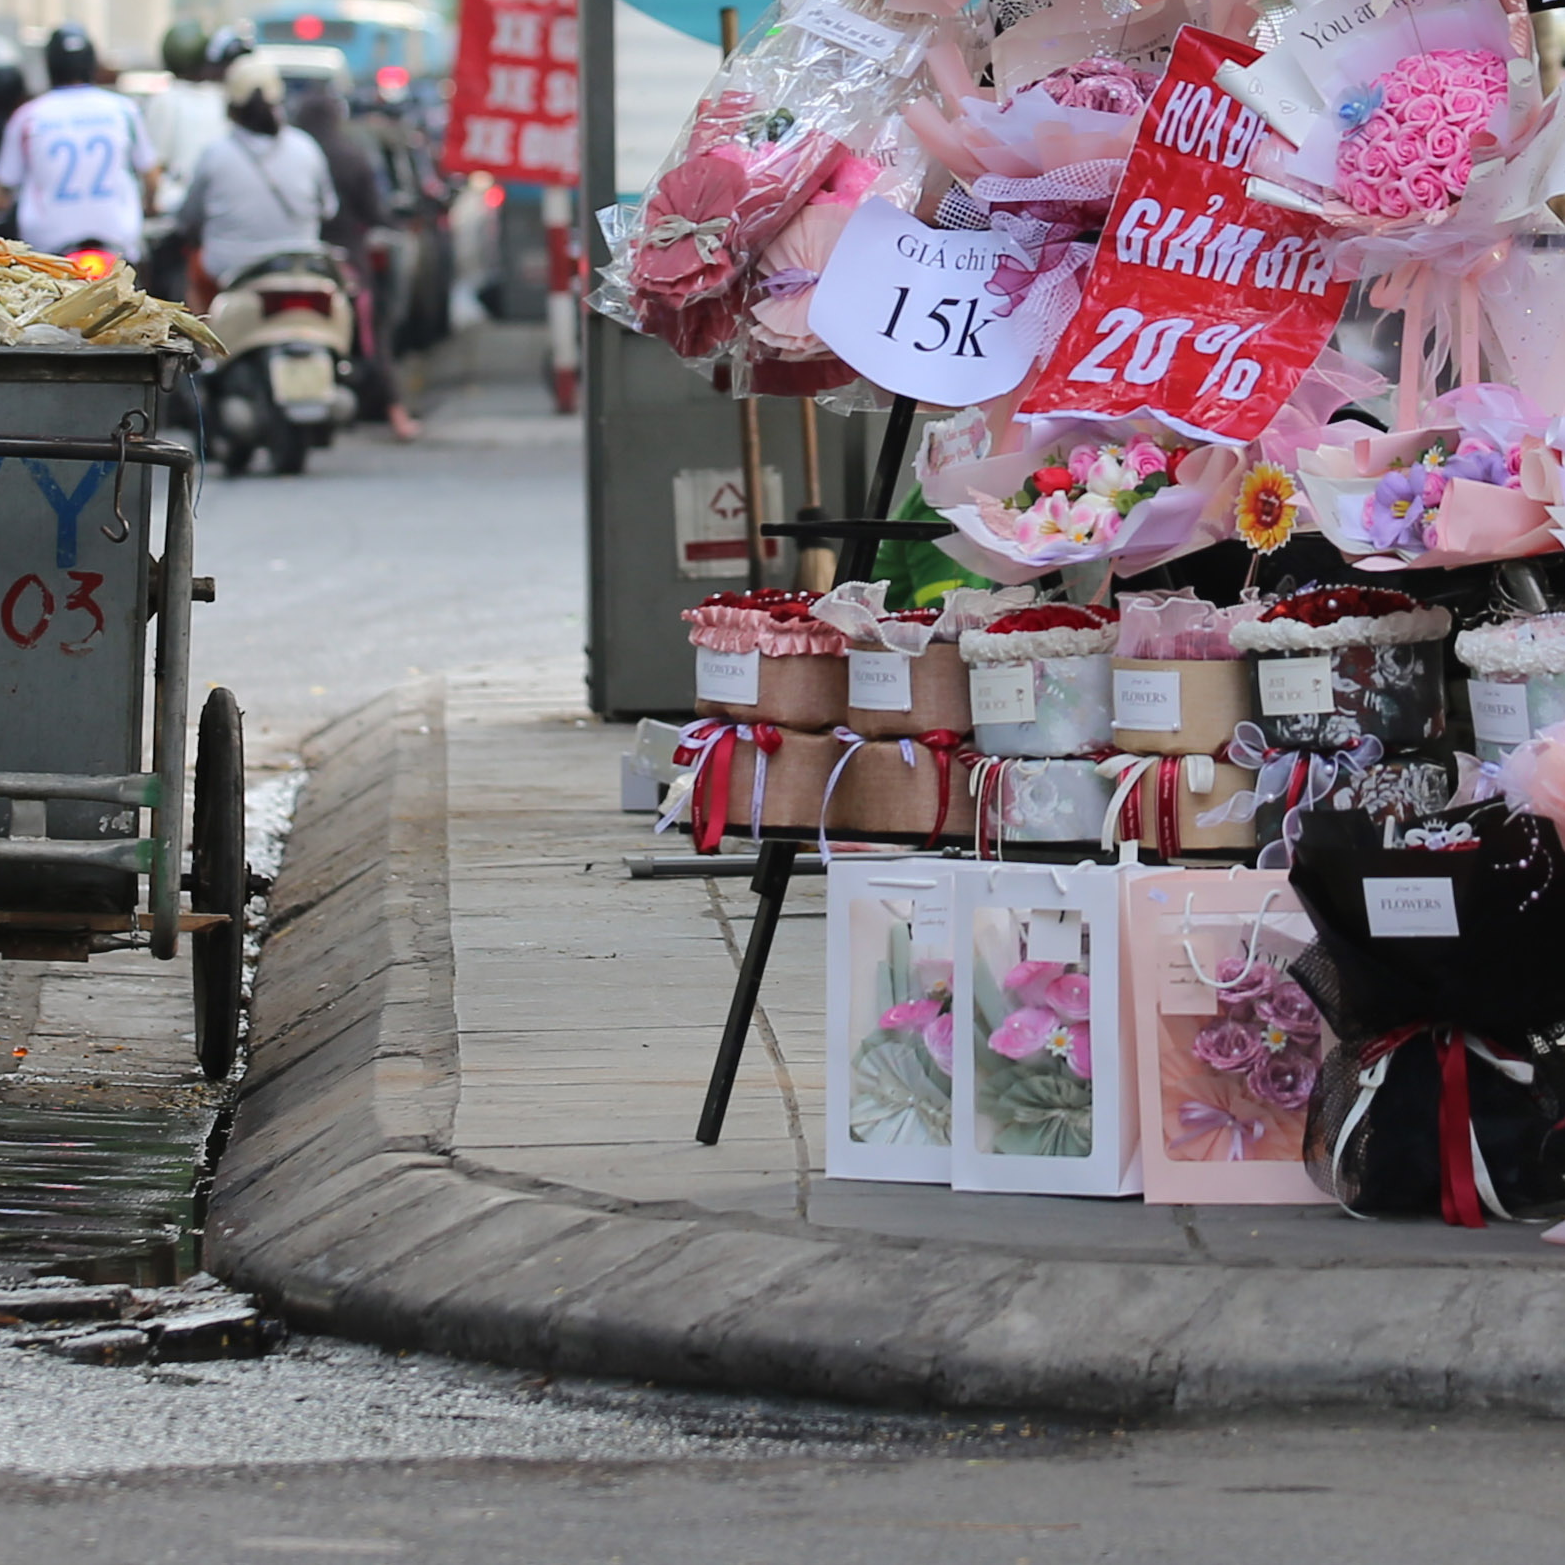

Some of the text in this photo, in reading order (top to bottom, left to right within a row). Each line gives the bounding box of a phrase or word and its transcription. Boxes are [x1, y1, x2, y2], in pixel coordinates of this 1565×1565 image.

[1299, 13, 1350, 52] You
[1154, 80, 1232, 162] HOA
[49, 134, 116, 202] 22
[896, 233, 947, 270] GIÁ
[1115, 195, 1258, 287] GIẢM
[877, 284, 996, 360] 15k
[1380, 897, 1443, 911] FLOWERS
